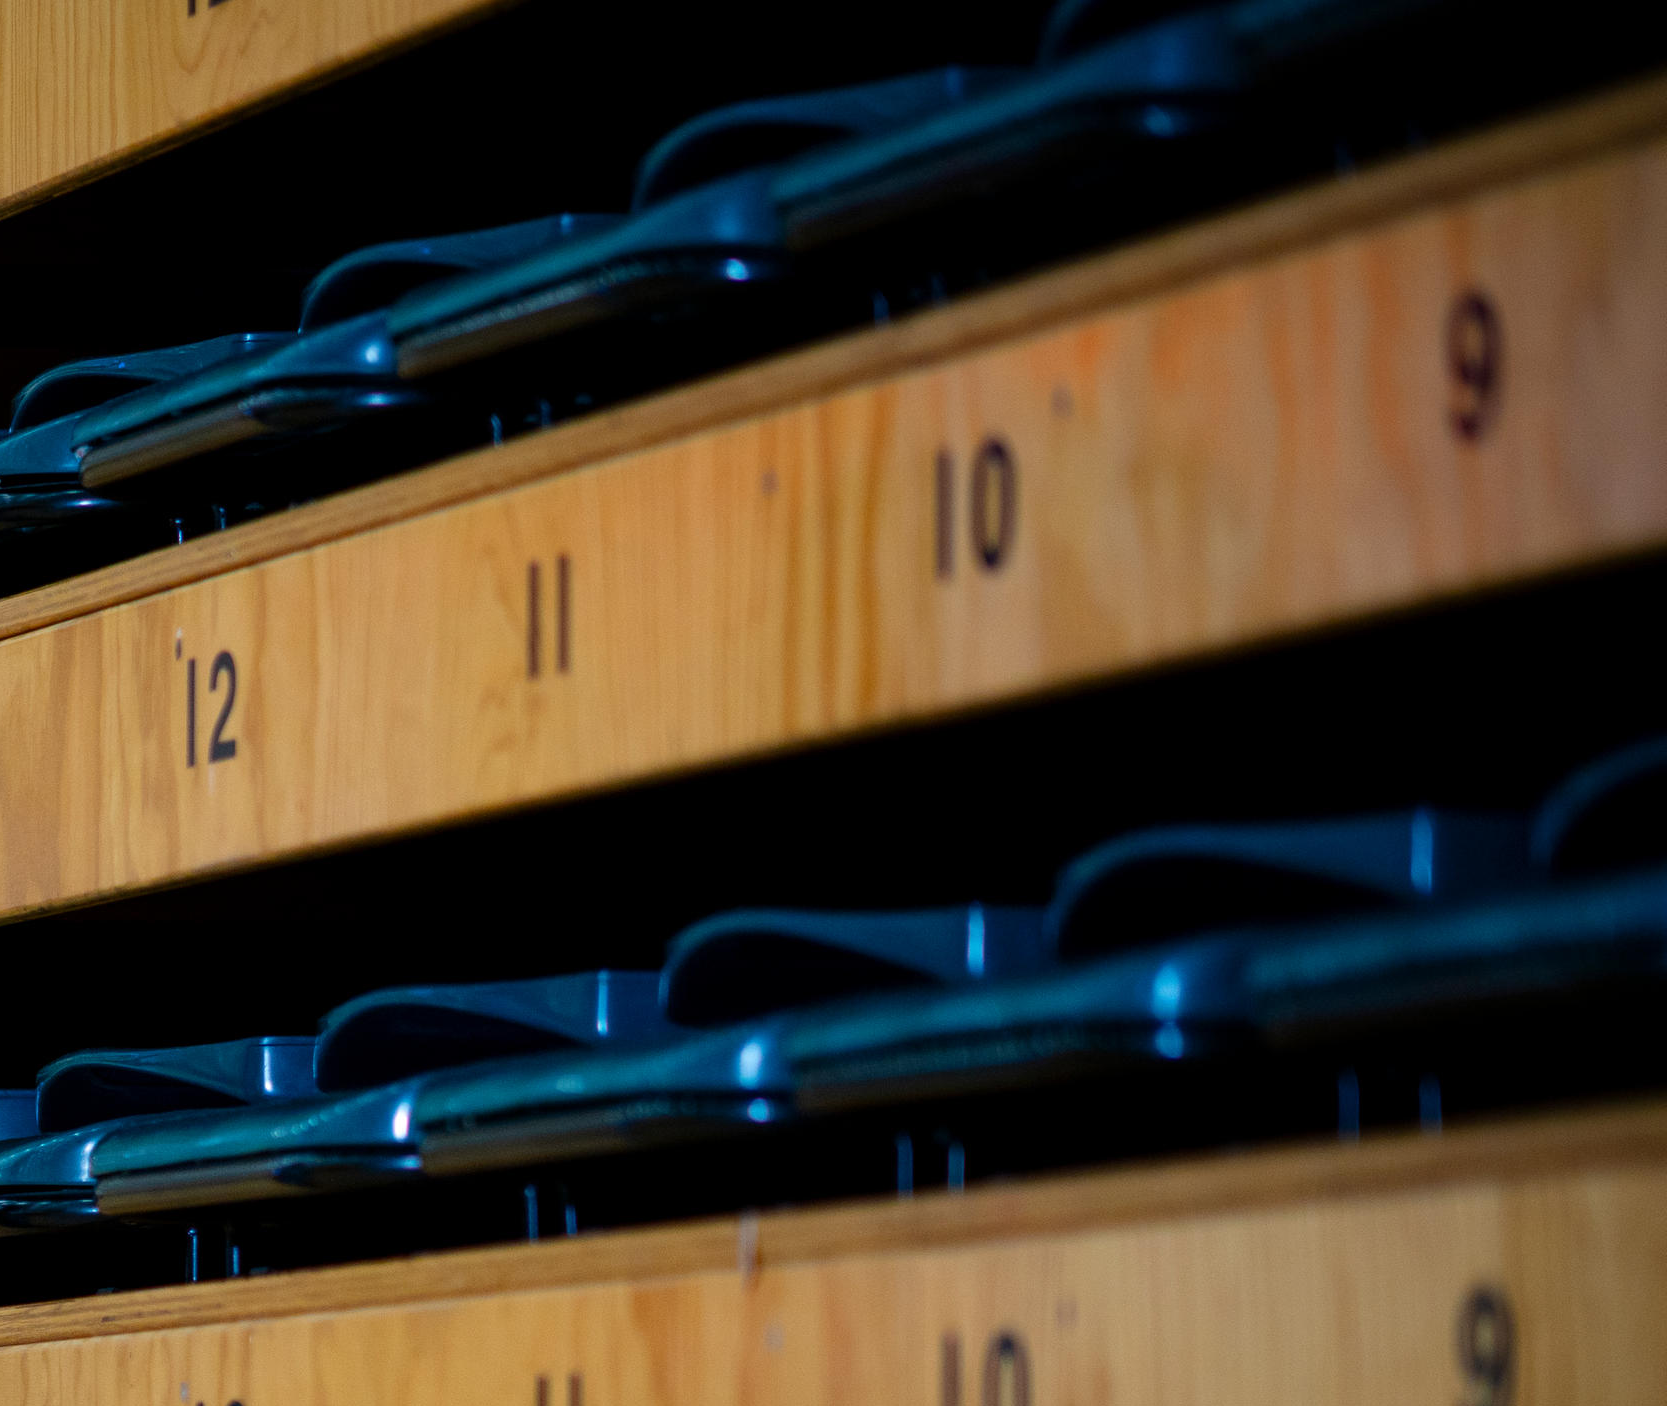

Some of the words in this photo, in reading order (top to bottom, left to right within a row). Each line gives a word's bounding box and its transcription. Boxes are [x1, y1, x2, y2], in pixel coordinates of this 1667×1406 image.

[1448, 291, 1502, 441] 9
[935, 438, 1016, 576] 10
[527, 555, 571, 679] 11
[188, 652, 236, 766] 12
